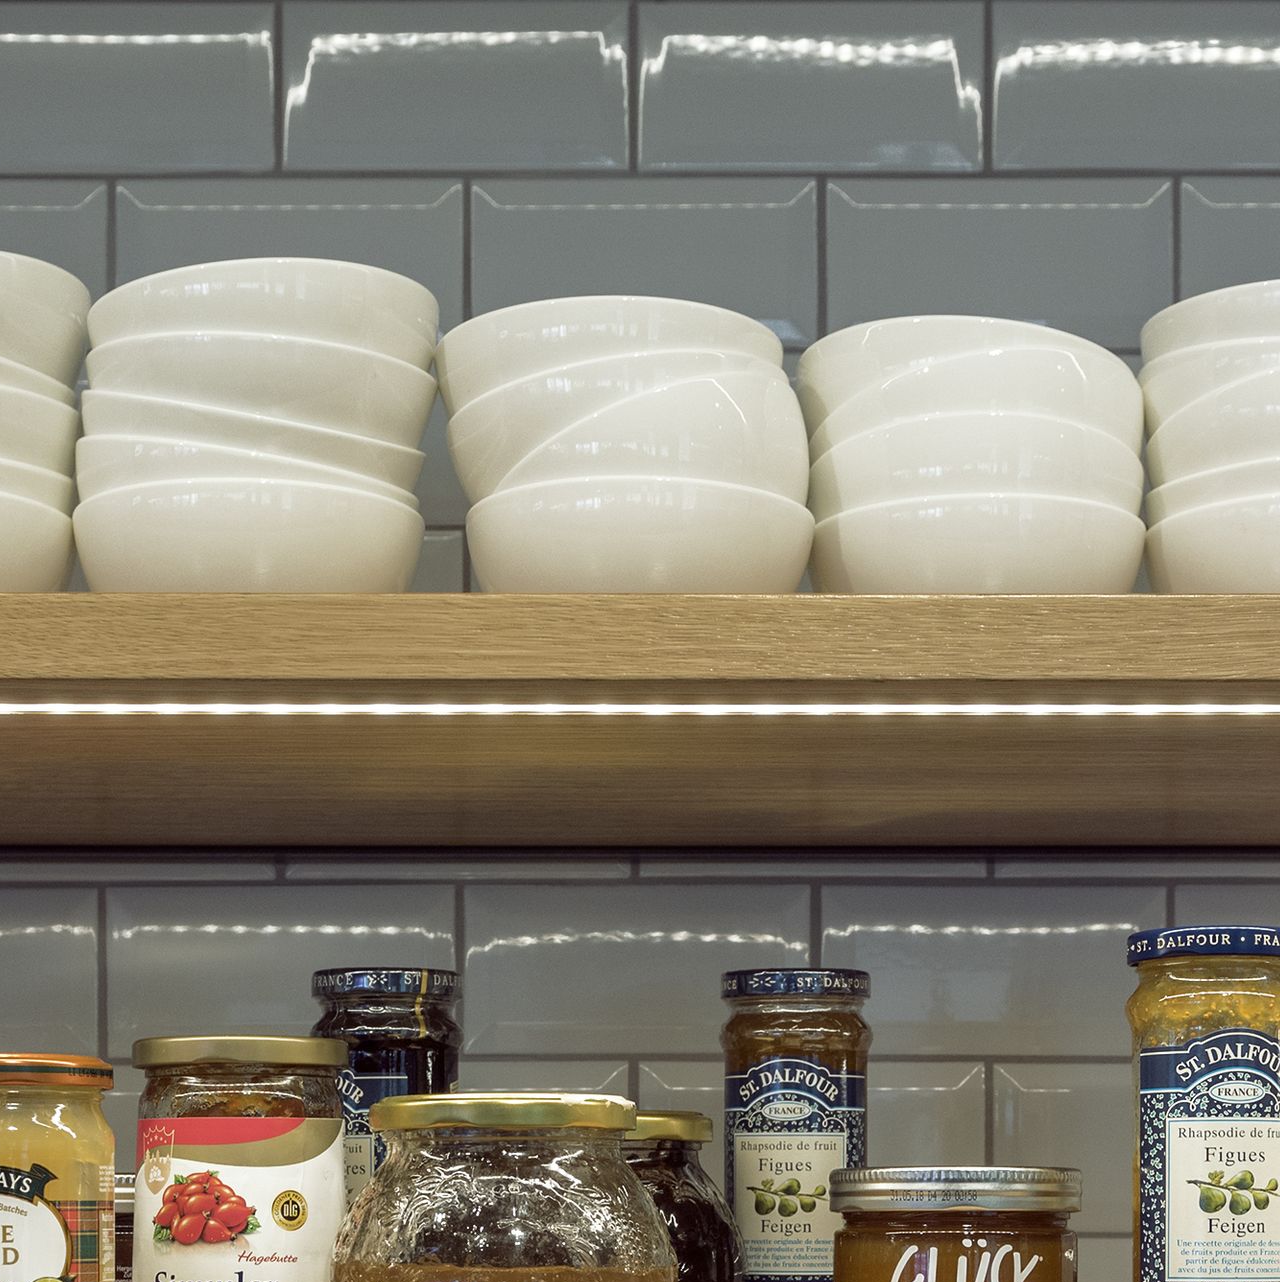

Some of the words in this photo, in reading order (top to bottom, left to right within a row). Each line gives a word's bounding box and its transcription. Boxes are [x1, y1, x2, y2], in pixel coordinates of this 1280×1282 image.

[1135, 939, 1152, 953] ST.
[1156, 933, 1232, 950] DALFOUR
[313, 973, 353, 988] FRANCE
[1175, 1058, 1206, 1082] ST.
[738, 1079, 760, 1102] ST.
[760, 1067, 840, 1102] DALFOUR
[1217, 1086, 1260, 1097] FRANCE
[768, 1106, 807, 1115] FRANCE
[1177, 1127, 1249, 1141] Rhapsodie
[1250, 1127, 1264, 1138] de
[740, 1140, 794, 1154] Rhapsodie
[796, 1140, 811, 1151] de
[813, 1140, 838, 1151] fruit
[1204, 1146, 1266, 1170] Figues
[758, 1157, 813, 1176] Figues
[760, 1218, 813, 1237] Feigen
[1207, 1217, 1266, 1238] Feigen
[1176, 1239, 1193, 1248] Une
[1194, 1240, 1222, 1248] recette
[1224, 1239, 1257, 1249] originale
[1258, 1239, 1267, 1247] de
[237, 1248, 299, 1265] Hagebutte
[1180, 1248, 1190, 1256] de
[1191, 1248, 1213, 1256] fruits
[1215, 1248, 1249, 1257] produite
[1185, 1257, 1208, 1266] partir
[1210, 1257, 1220, 1265] de
[1221, 1257, 1245, 1267] figues
[1197, 1266, 1208, 1274] du
[1208, 1266, 1221, 1275] jus
[1222, 1266, 1232, 1274] de
[1234, 1266, 1255, 1274] fruits
